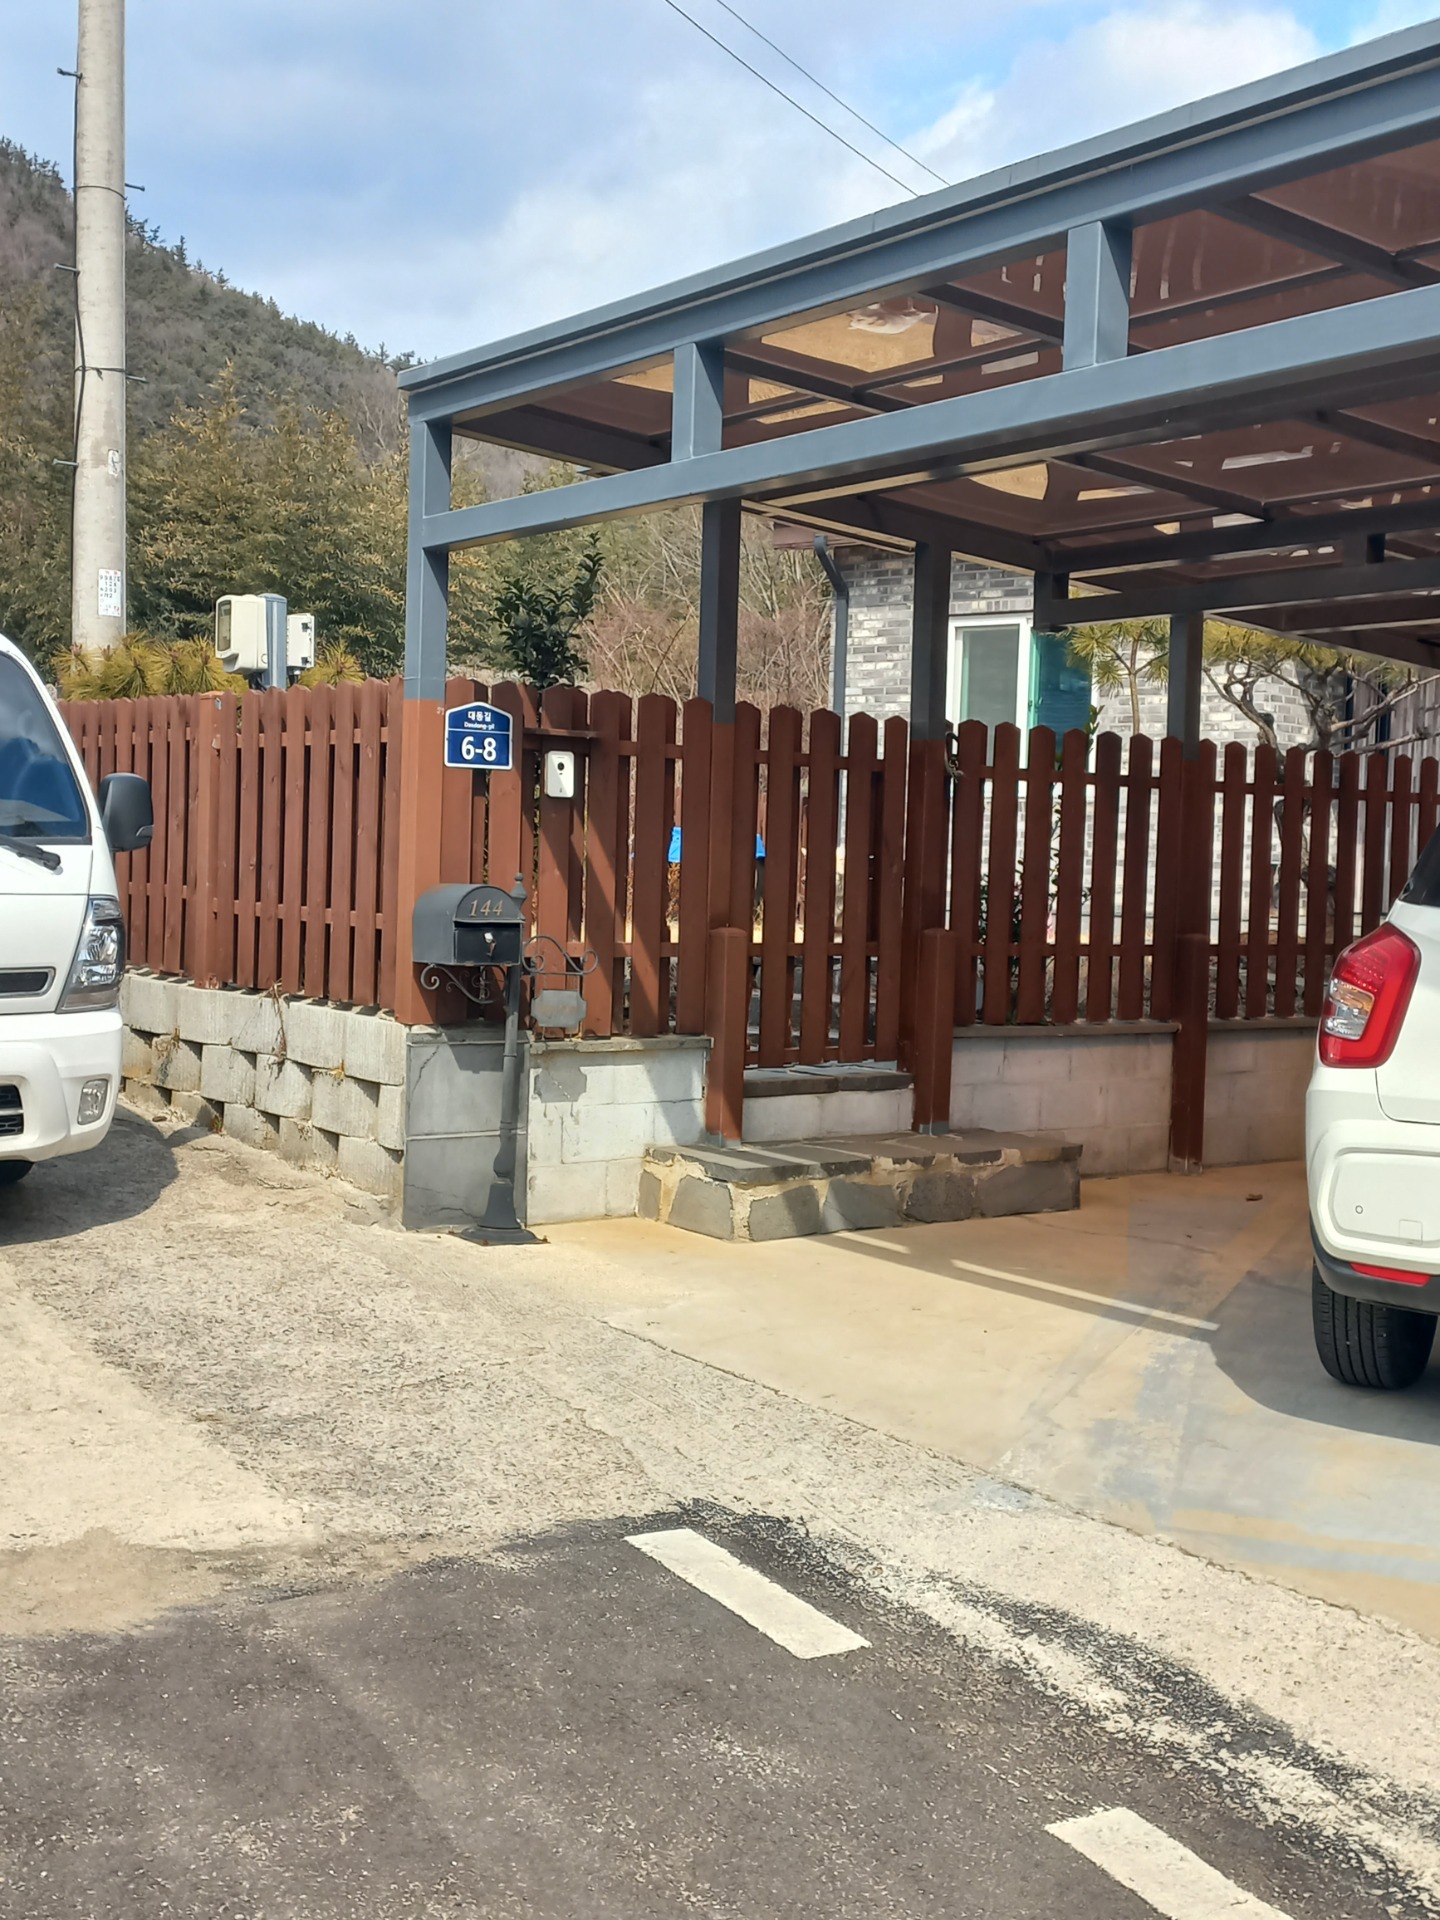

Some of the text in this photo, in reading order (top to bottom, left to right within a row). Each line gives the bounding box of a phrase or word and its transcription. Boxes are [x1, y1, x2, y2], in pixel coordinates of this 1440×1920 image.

[468, 711, 492, 722] 대동길
[461, 736, 497, 762] 6-8
[469, 899, 503, 917] 144
